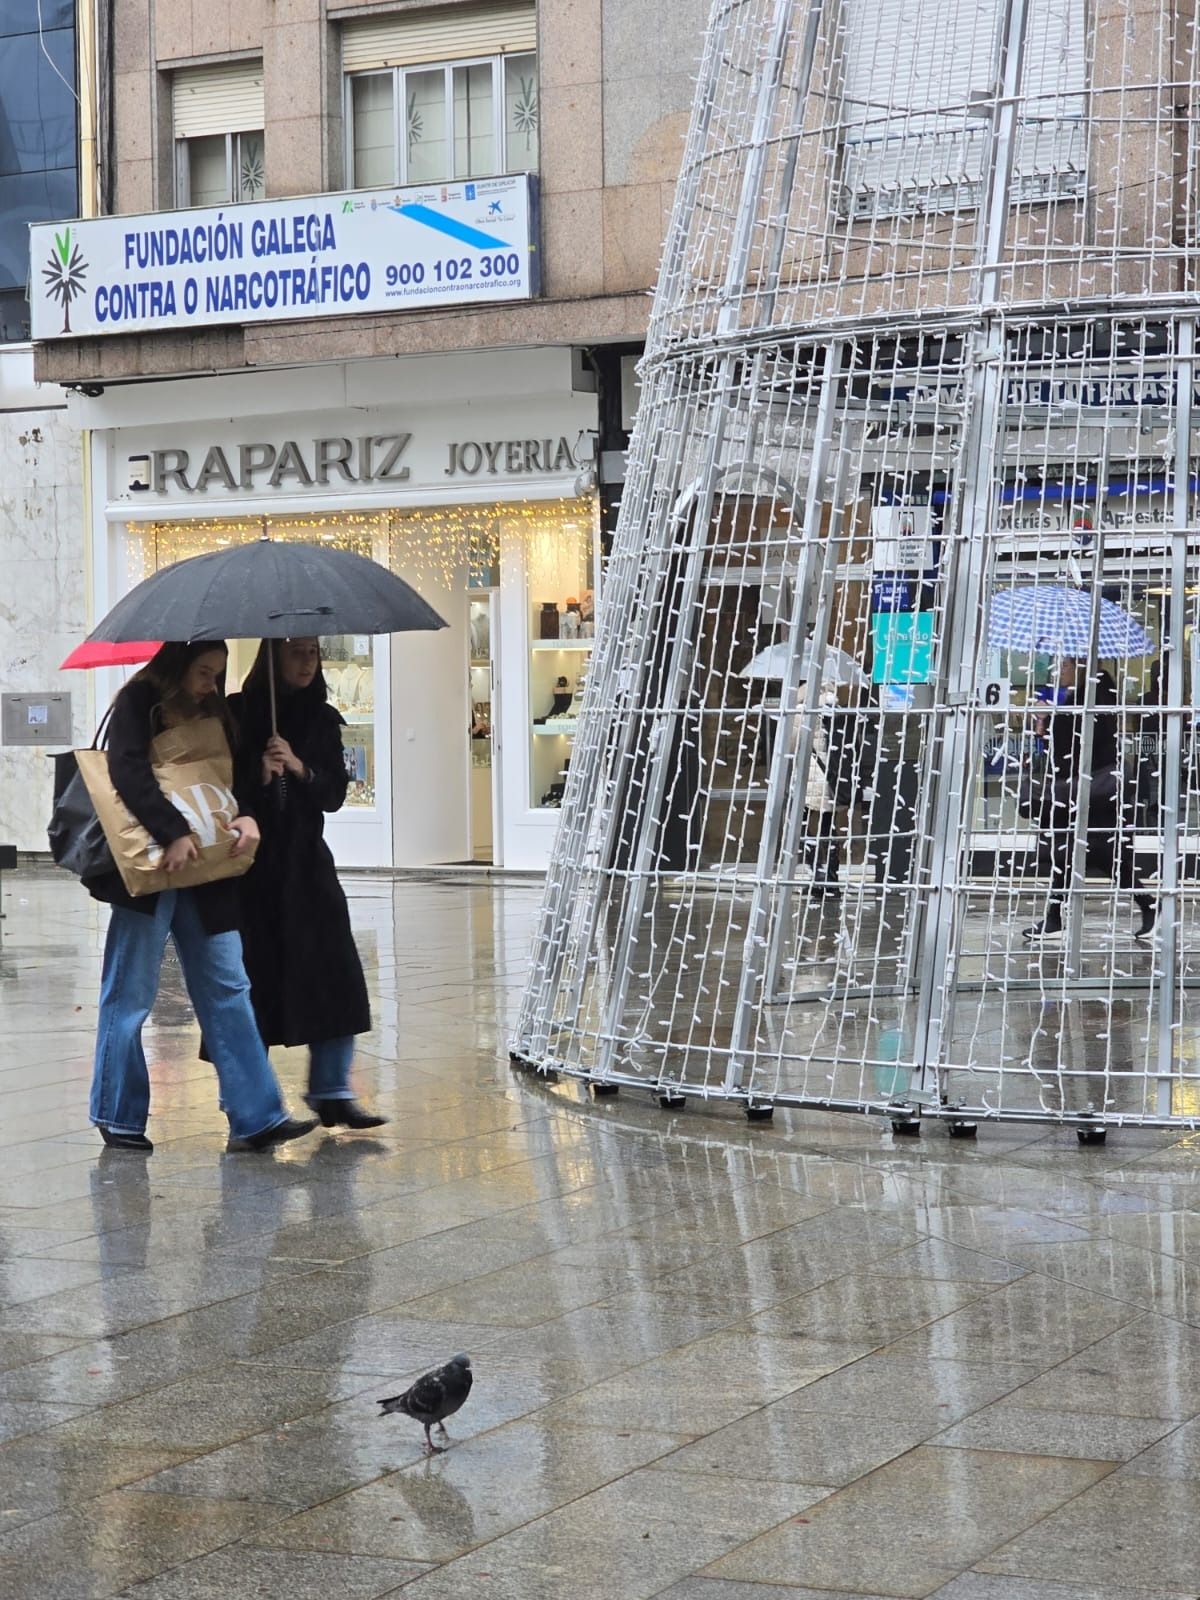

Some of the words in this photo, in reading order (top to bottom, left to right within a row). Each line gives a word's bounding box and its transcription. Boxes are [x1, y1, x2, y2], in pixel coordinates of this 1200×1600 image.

[125, 213, 243, 269] FUNDACIÓN
[252, 213, 336, 257] GALEGA
[385, 278, 521, 297] www.fundacioncontraonarcotrafico.org
[386, 262, 425, 286] 900
[434, 258, 472, 281] 102
[480, 253, 519, 277] 300
[95, 281, 176, 322] CONTRA
[184, 278, 198, 314] O
[206, 256, 370, 313] NARCOTRÁFICO
[151, 432, 412, 493] RAPARIZ
[444, 436, 577, 475] JOYERIA
[997, 512, 1051, 530] oterías
[985, 682, 1001, 706] 6
